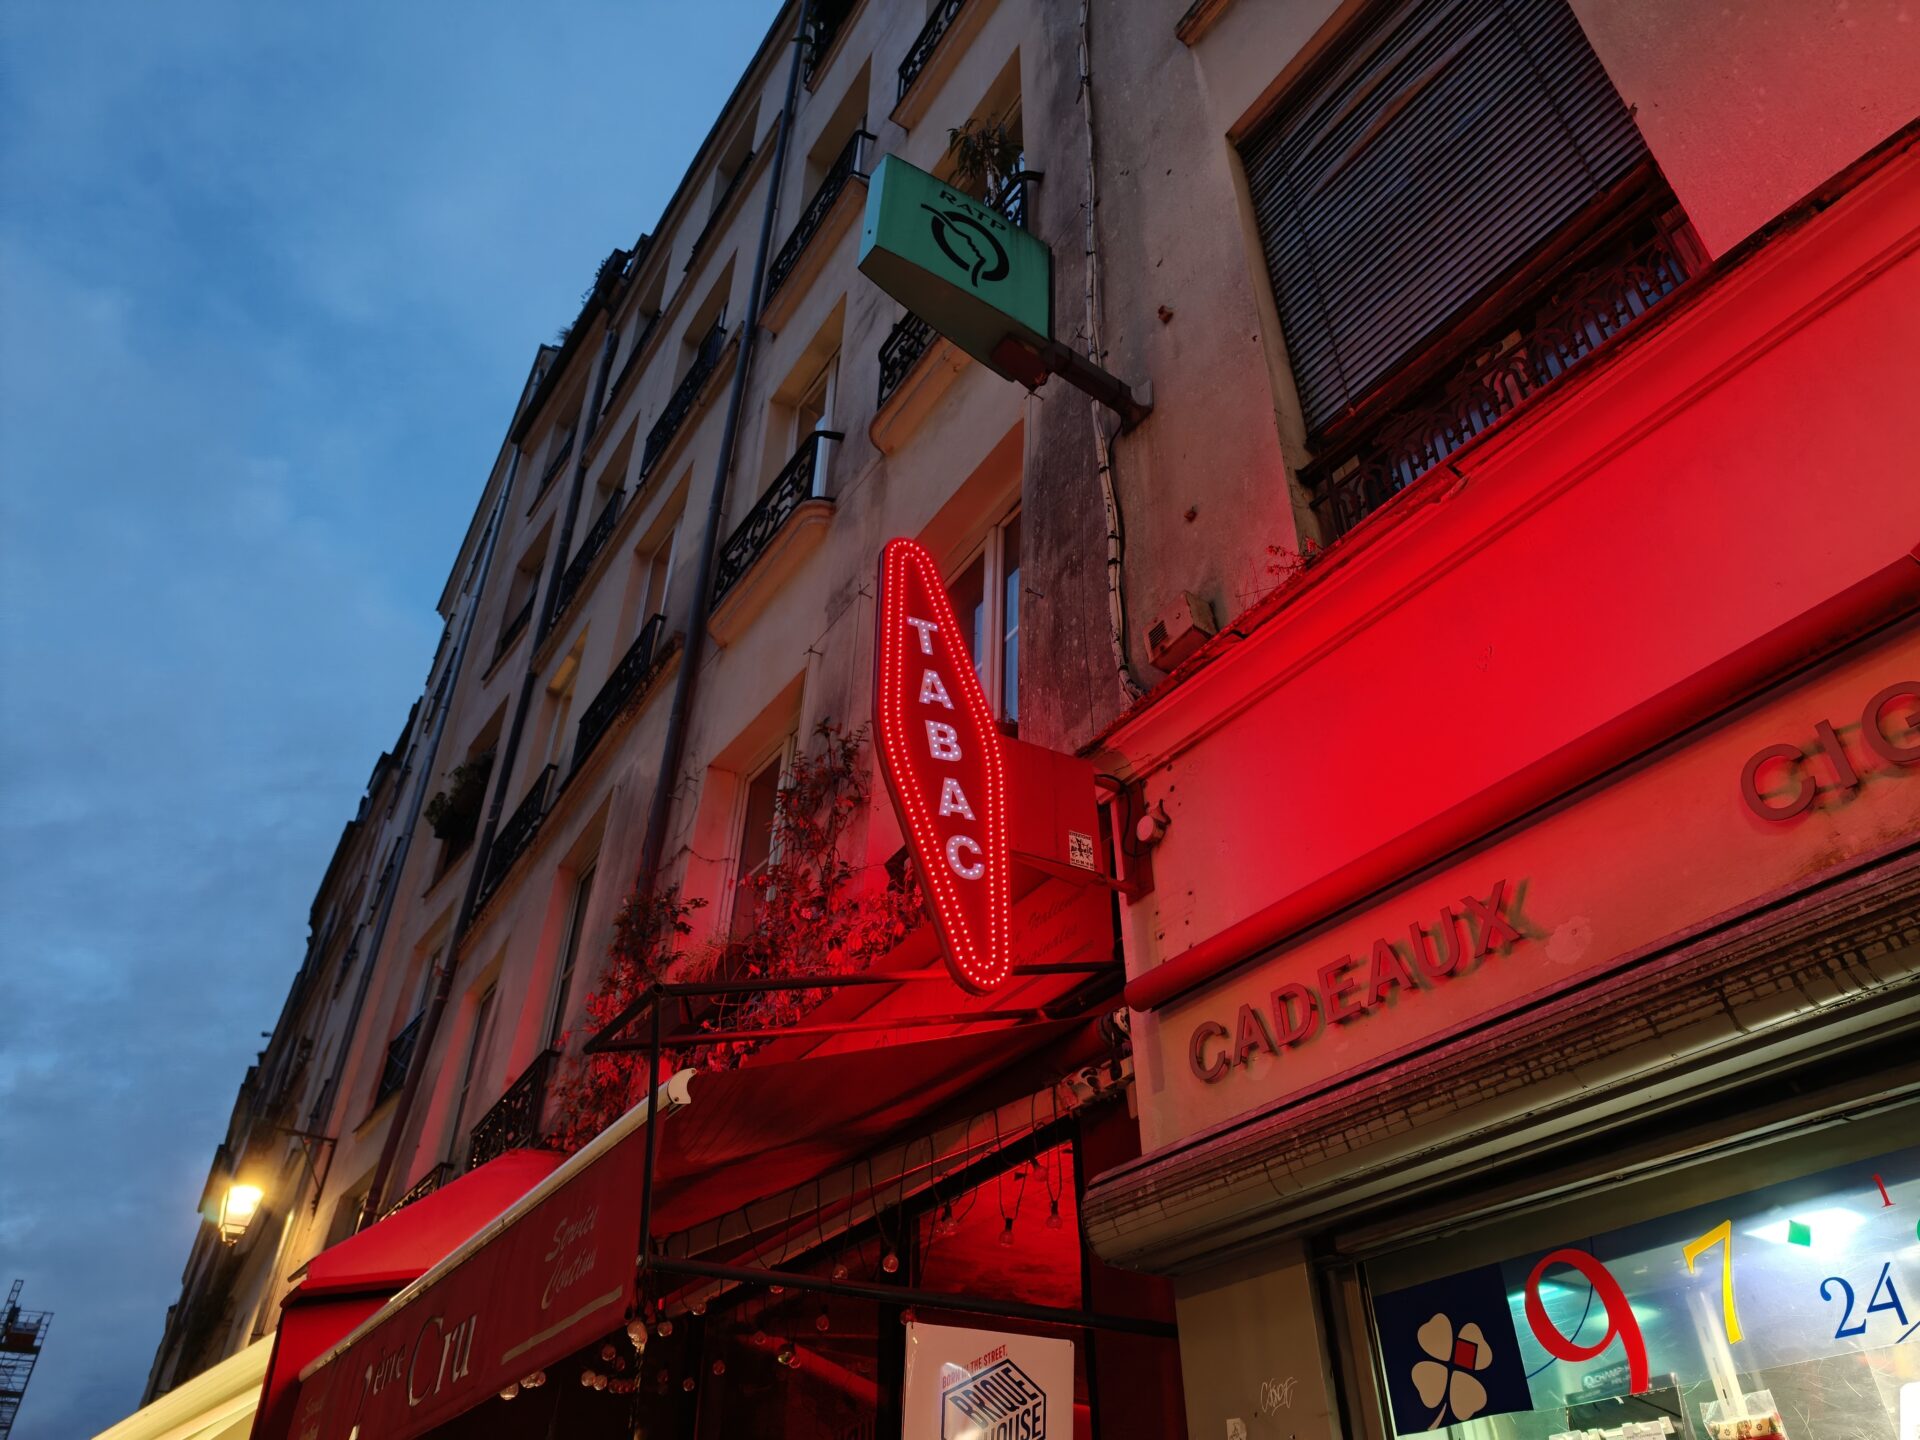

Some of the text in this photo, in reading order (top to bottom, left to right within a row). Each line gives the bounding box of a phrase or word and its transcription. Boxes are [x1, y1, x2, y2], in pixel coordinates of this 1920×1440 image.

[939, 190, 1007, 231] RATP
[906, 616, 986, 881] TABAC
[1189, 879, 1523, 1083] CADEAUX
[1525, 1248, 1649, 1394] 9
[1683, 1219, 1743, 1344] 7
[1820, 1261, 1909, 1339] 24
[408, 1314, 477, 1407] Cru
[949, 1367, 1039, 1430] BRIQUE
[971, 1356, 982, 1374] THE
